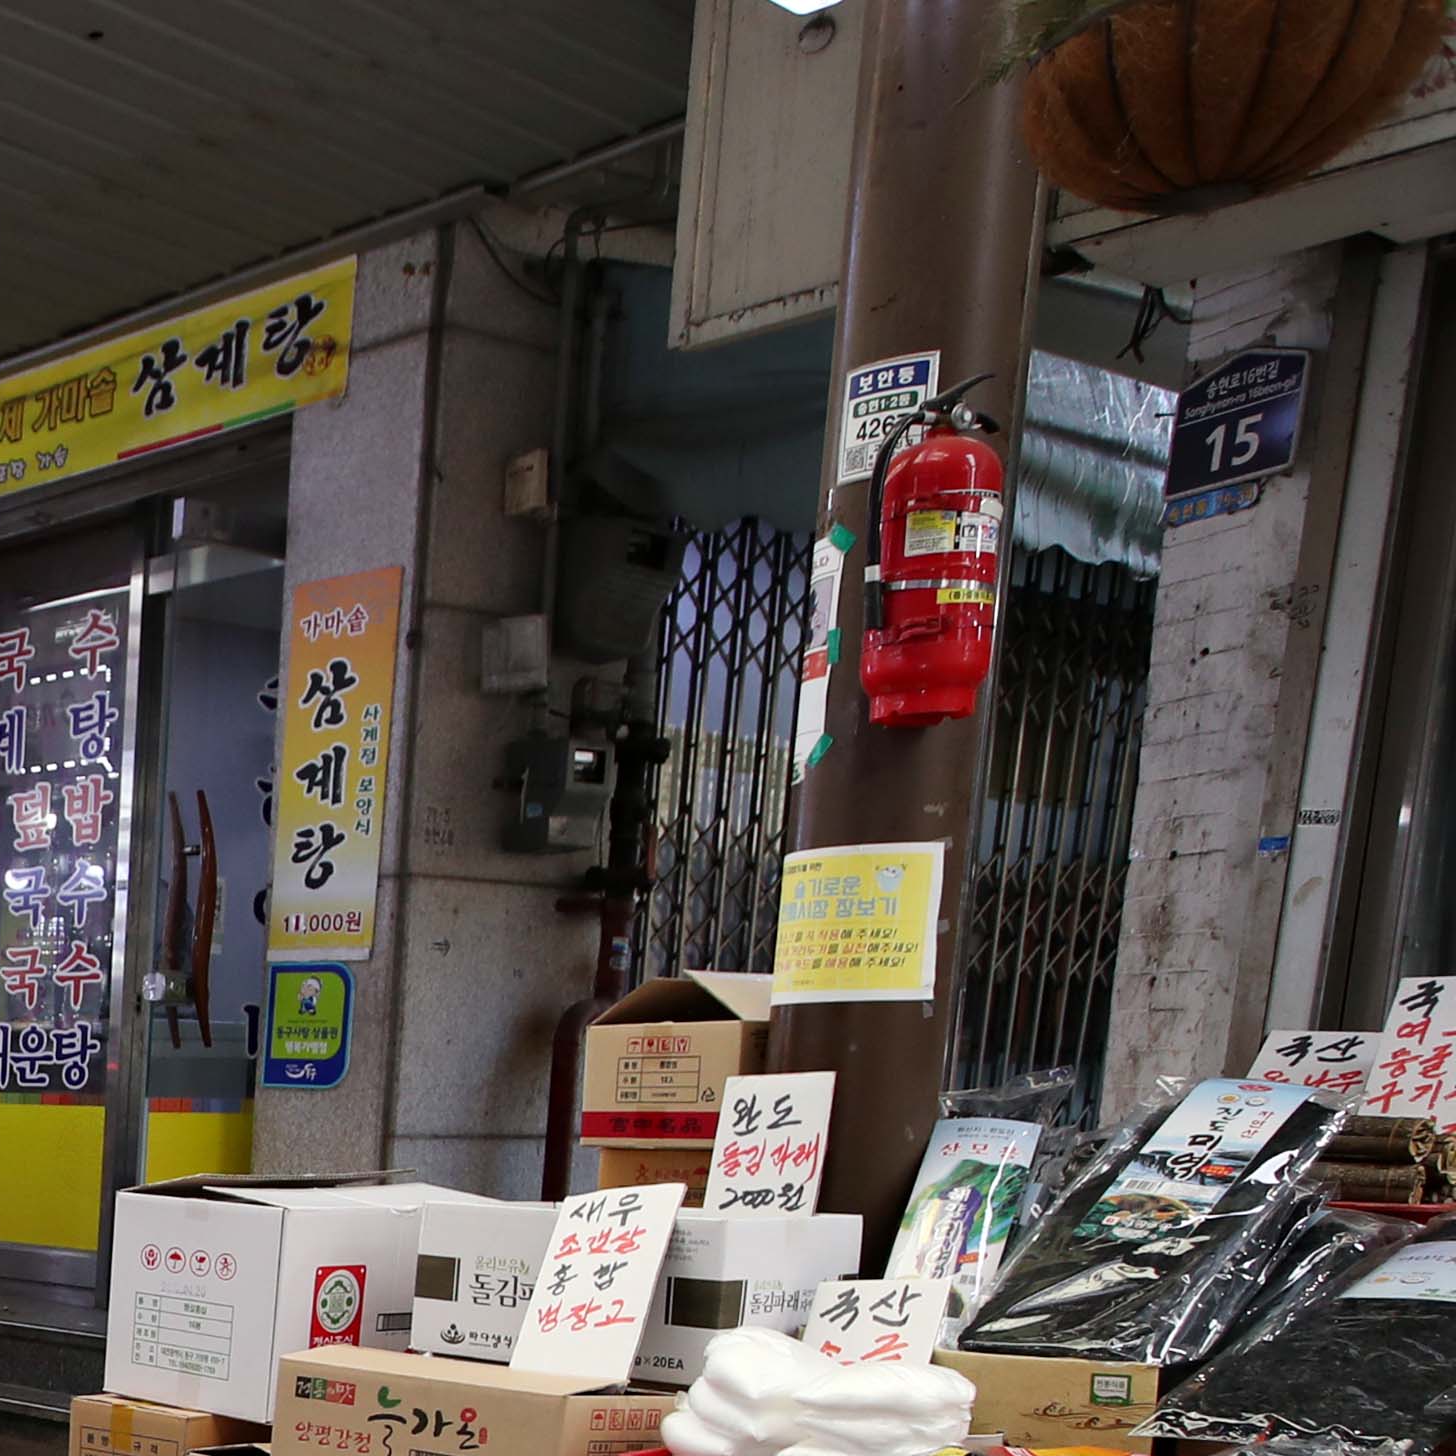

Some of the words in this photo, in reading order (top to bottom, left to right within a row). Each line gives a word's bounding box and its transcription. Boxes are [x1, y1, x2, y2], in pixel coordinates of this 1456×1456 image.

[133, 294, 324, 416] 삼계탕
[858, 365, 916, 395] 보안등
[32, 366, 118, 433] 가마솥
[1205, 413, 1264, 473] 15
[300, 604, 368, 642] 가마솥
[290, 656, 358, 891] 삼계탕
[835, 896, 898, 920] 장보기
[1275, 1034, 1365, 1067] 국산
[731, 1093, 802, 1137] 완도
[569, 1192, 644, 1228] 새우
[545, 1260, 629, 1297] 홍합
[534, 1298, 638, 1335] 냉장고
[749, 1288, 801, 1314] 돌김파래
[819, 1284, 922, 1332] 국산
[295, 1419, 372, 1454] 양평강정
